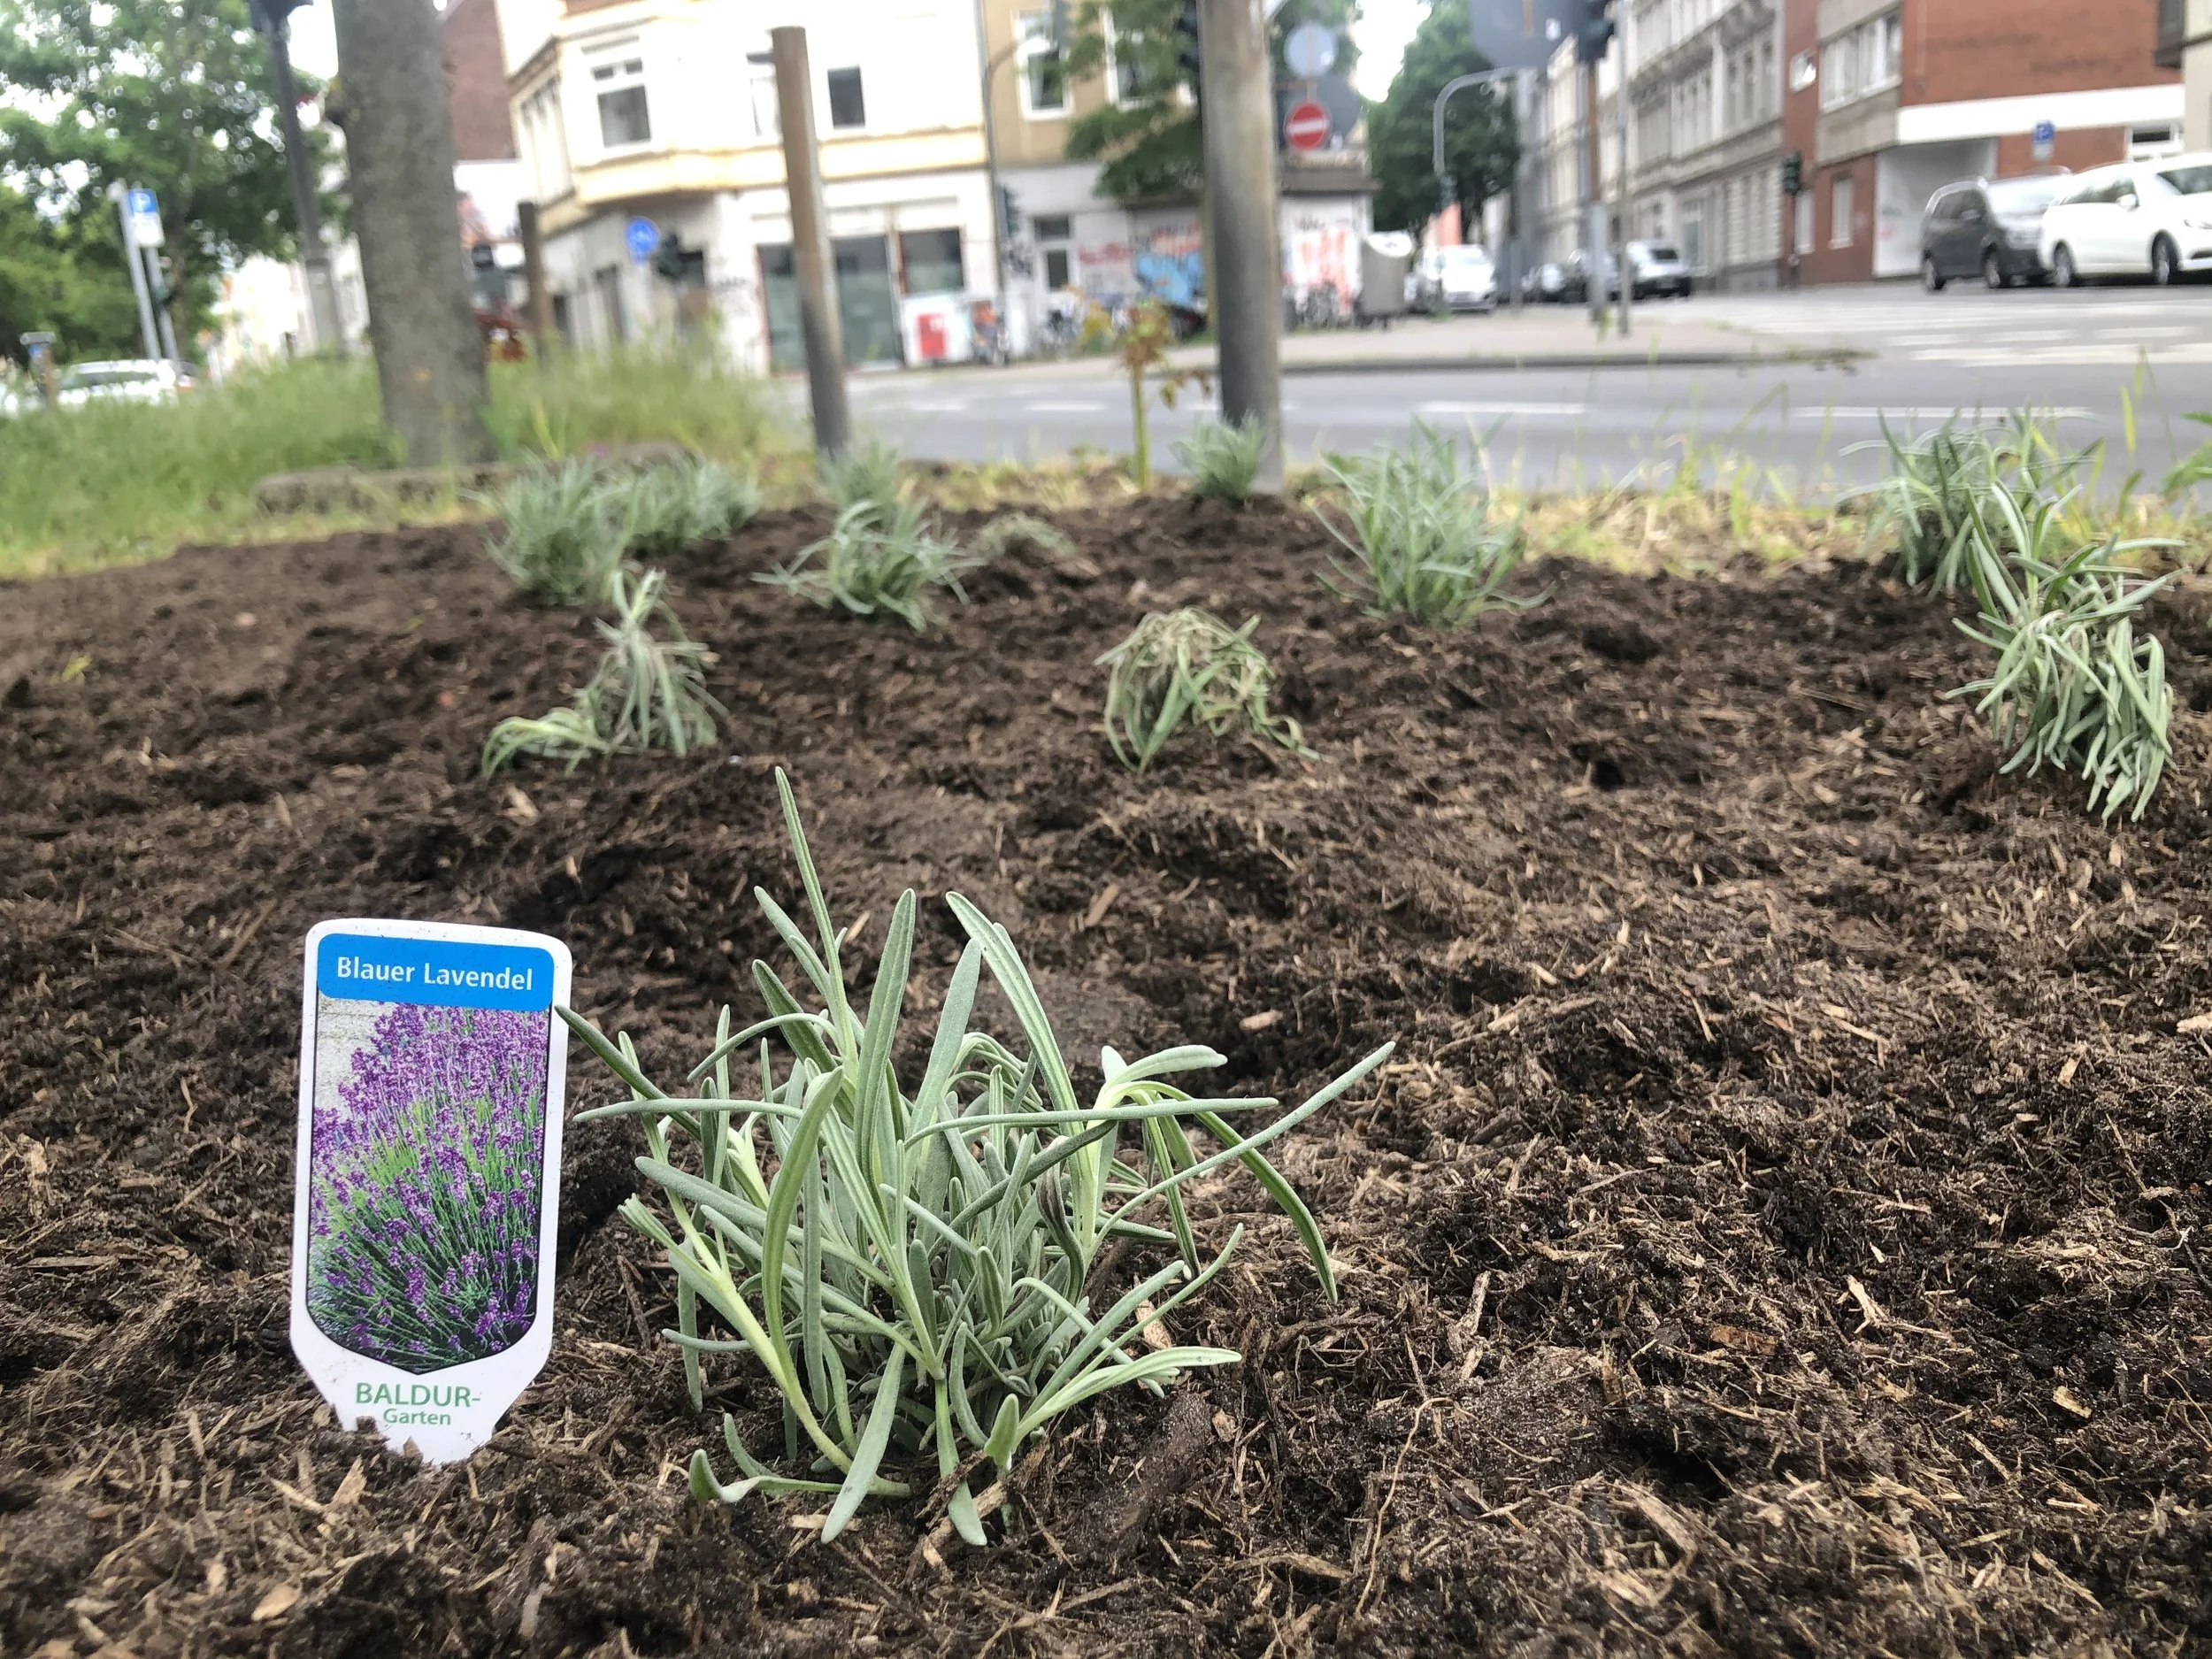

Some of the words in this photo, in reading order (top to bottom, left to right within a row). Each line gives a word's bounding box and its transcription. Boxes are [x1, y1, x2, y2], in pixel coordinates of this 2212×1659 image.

[337, 956, 416, 983] Blauer
[424, 962, 533, 991] Lavendel
[356, 1381, 481, 1408] BALDUR-
[383, 1408, 451, 1425] Garten
